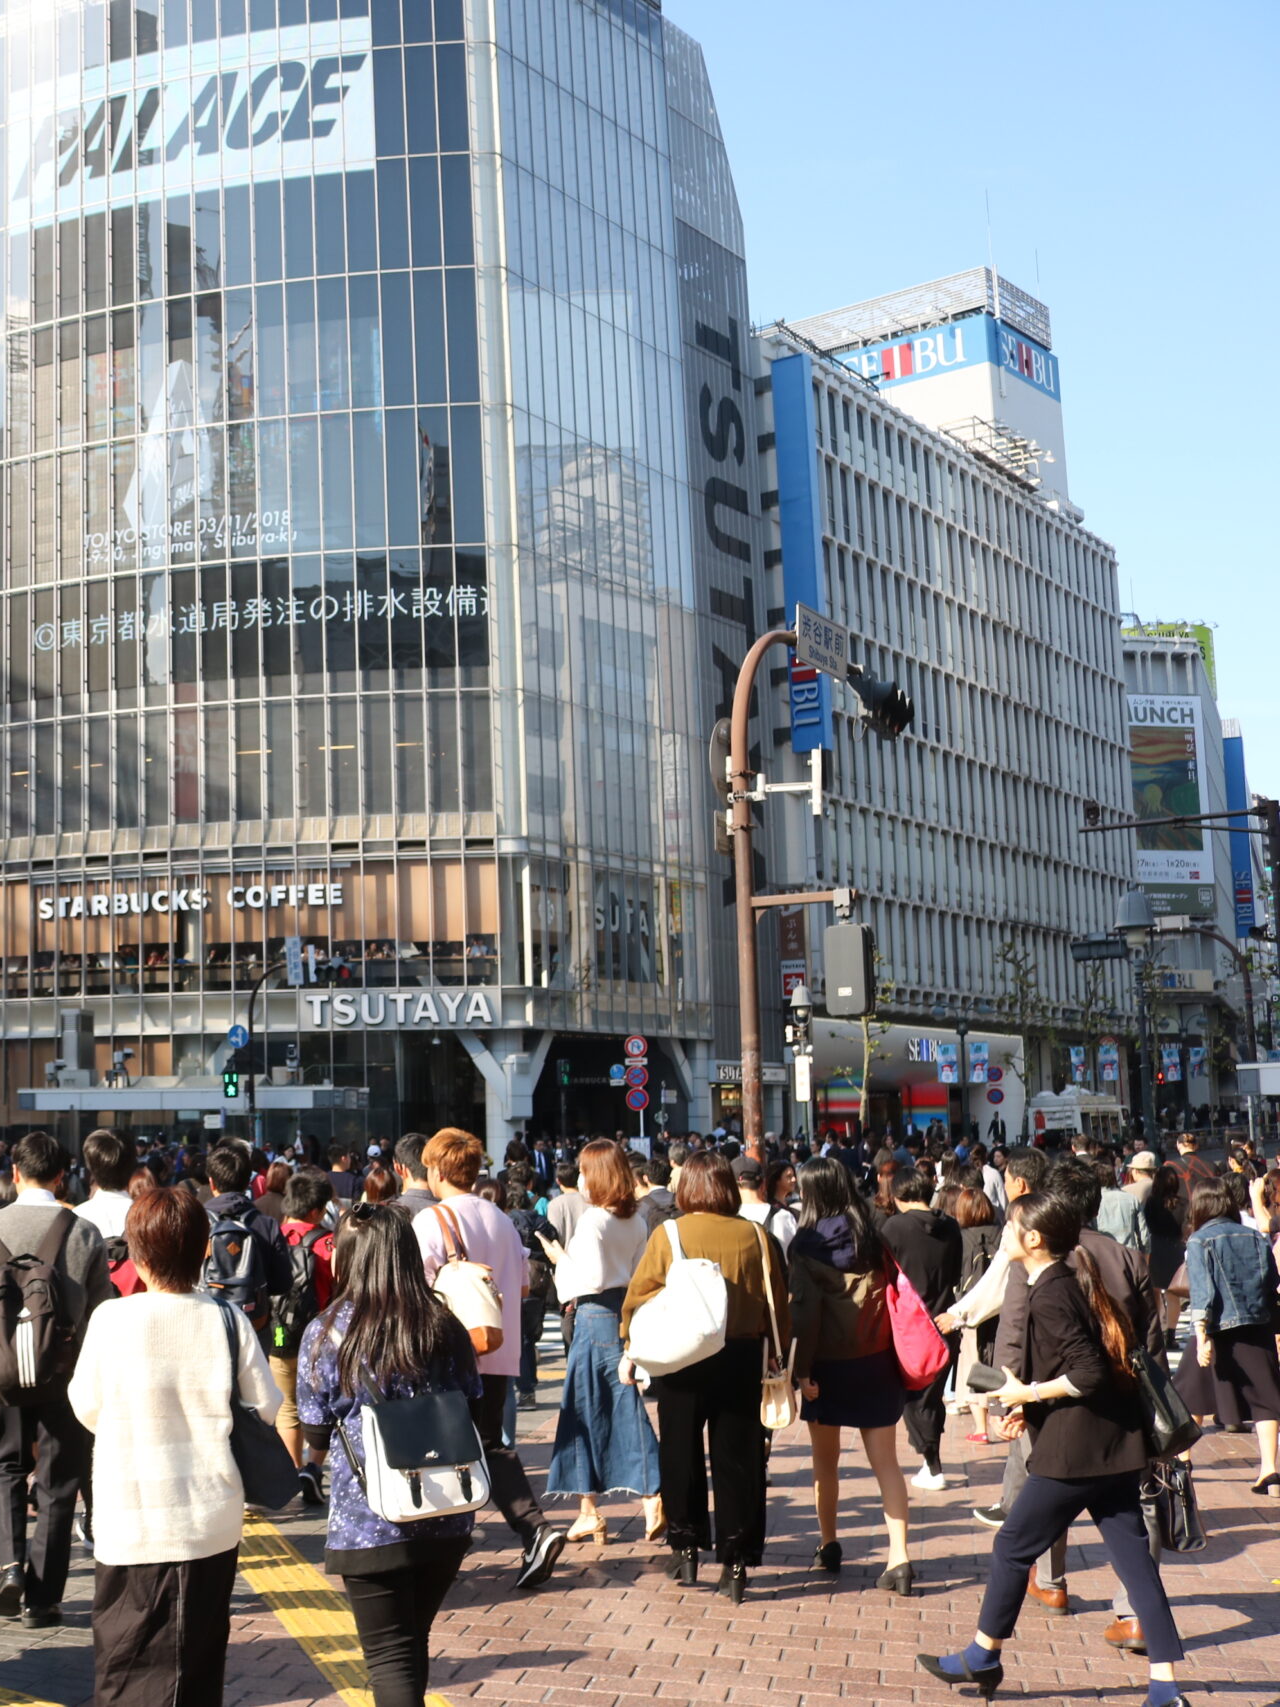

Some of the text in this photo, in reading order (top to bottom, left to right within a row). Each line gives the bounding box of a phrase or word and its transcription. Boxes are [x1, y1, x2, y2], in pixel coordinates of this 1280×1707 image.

[13, 54, 368, 200] PALACE
[1001, 332, 1055, 393] SEIBU
[143, 519, 192, 541] STORE
[213, 527, 297, 549] Sibua-ku
[802, 613, 844, 658] 渋谷駅前
[808, 645, 829, 668] Shibuya
[39, 883, 343, 920] STARBUCKS COFFEE
[1234, 870, 1256, 925] SEIBU
[786, 975, 803, 991] 本
[306, 992, 494, 1026] TSUTAYA
